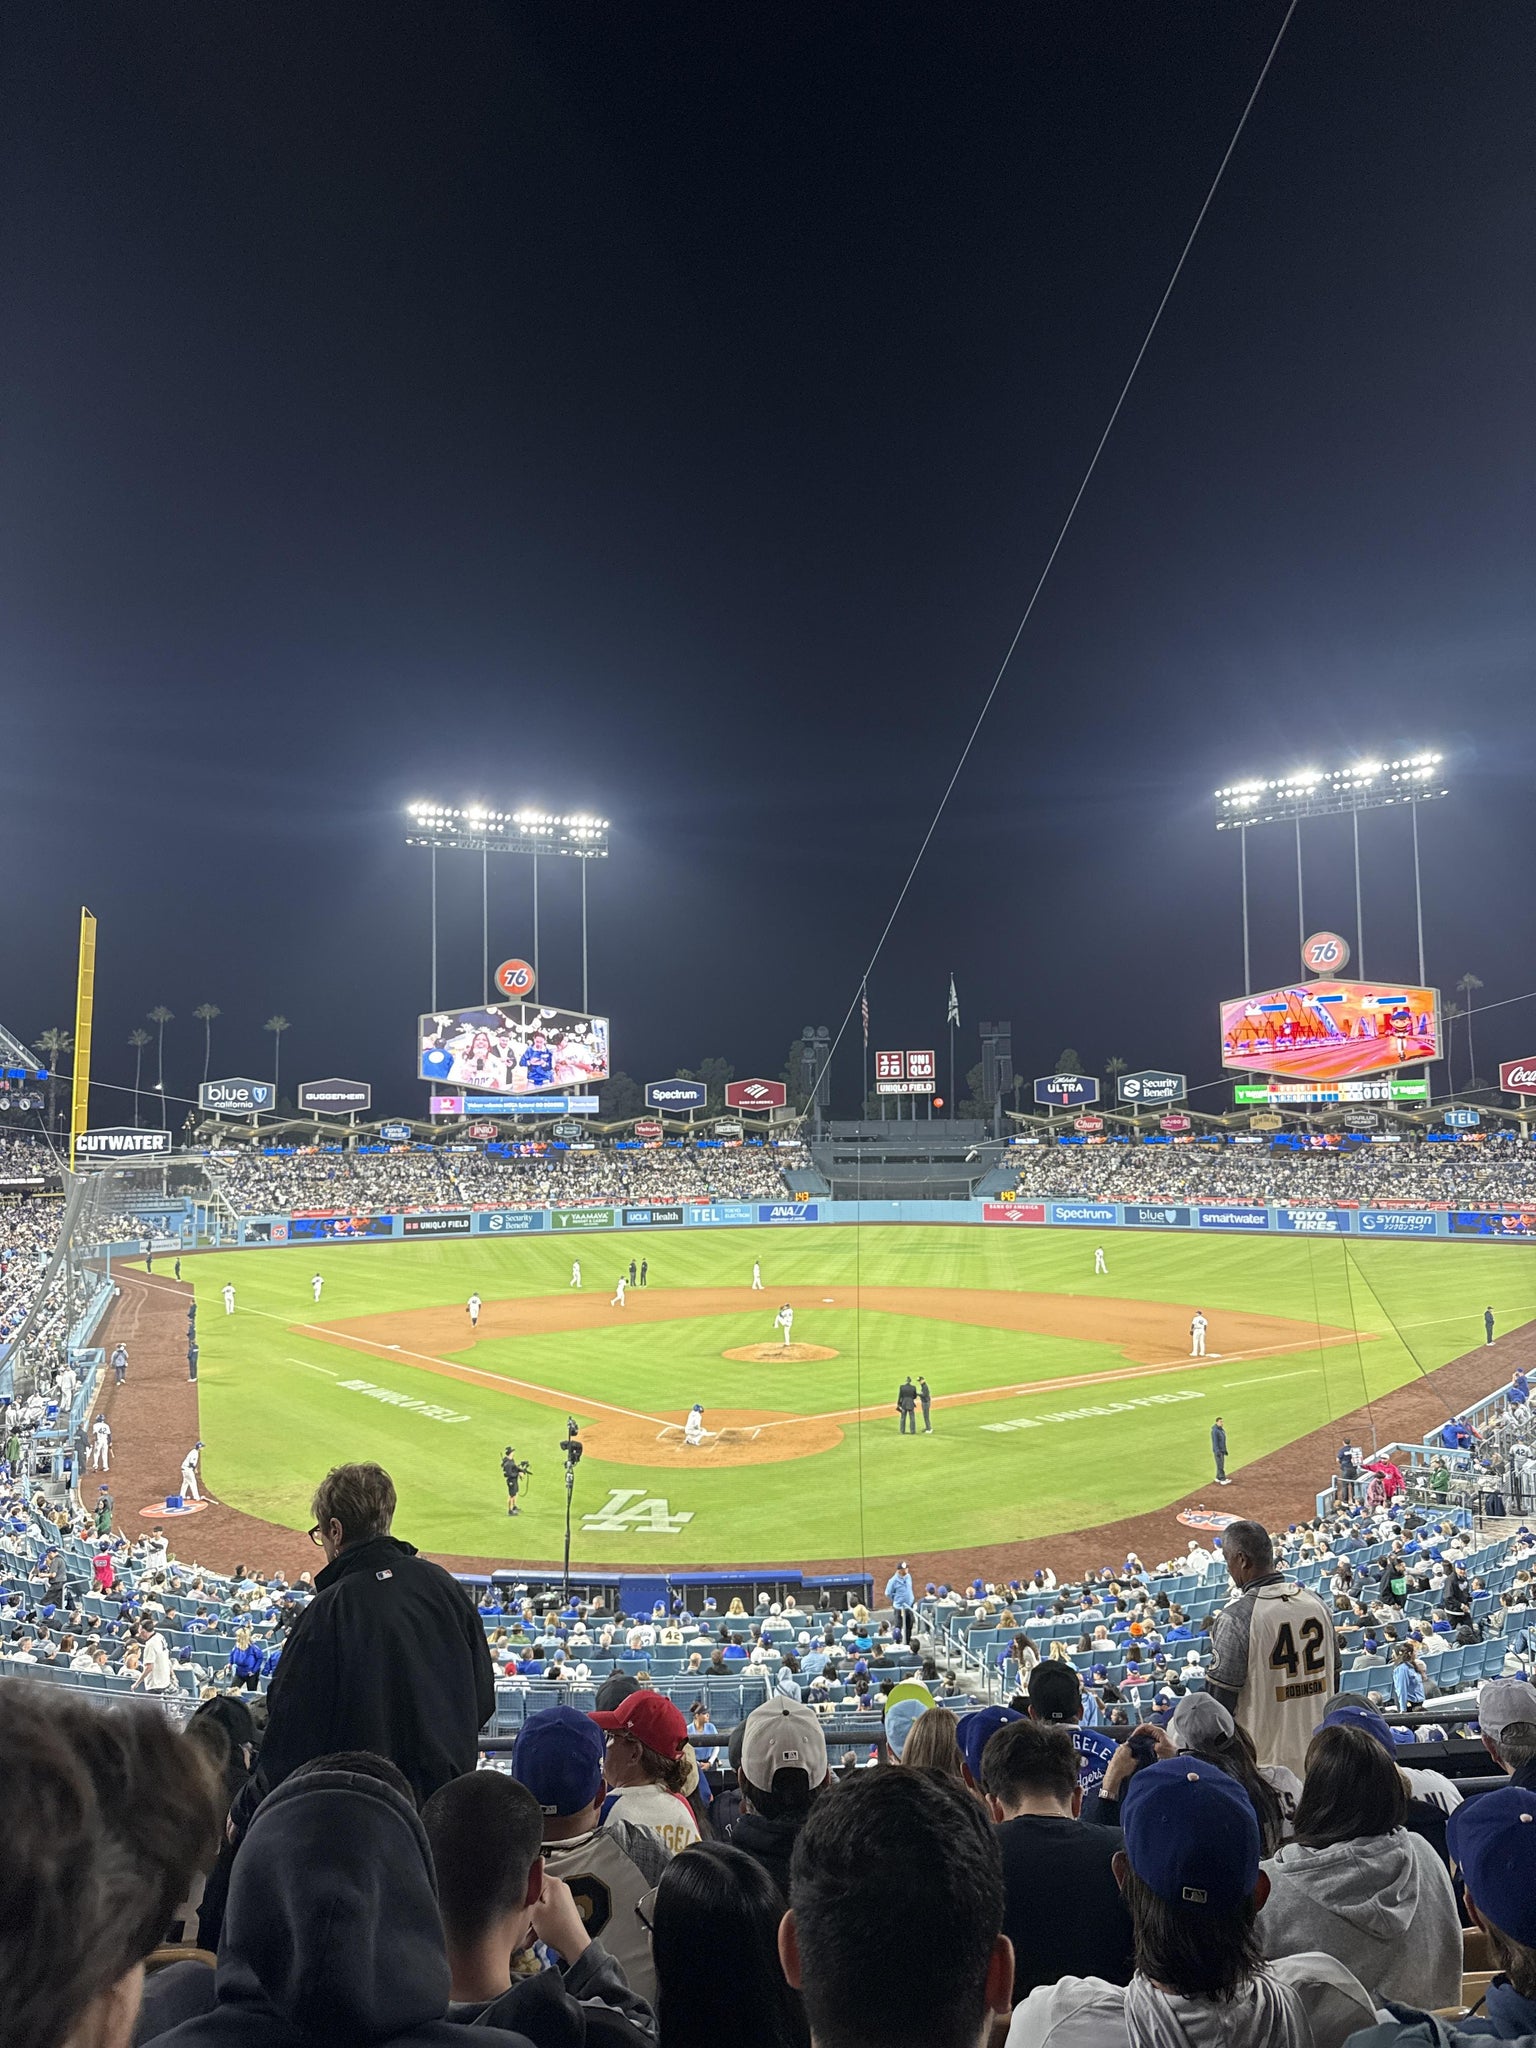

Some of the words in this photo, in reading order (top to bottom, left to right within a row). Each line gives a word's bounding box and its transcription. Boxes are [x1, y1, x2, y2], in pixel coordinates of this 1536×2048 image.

[1311, 940, 1339, 963] 76
[505, 968, 529, 988] 76
[910, 1054, 929, 1065] UNI
[910, 1065, 932, 1076] QLO
[879, 1083, 908, 1092] UNIQLO
[909, 1082, 932, 1092] FIELD
[1047, 1083, 1084, 1093] ULTRA
[1143, 1079, 1178, 1089] Security
[207, 1085, 249, 1101] blue
[305, 1092, 366, 1100] GUGGENHEIM
[652, 1089, 698, 1101] Spectrum
[1143, 1087, 1174, 1097] Benefit
[1449, 1113, 1475, 1124] TEL
[474, 1126, 494, 1135] JINRO
[76, 1135, 164, 1151] CUTWATER
[629, 1213, 649, 1221] UCLA
[652, 1211, 679, 1221] Health
[691, 1208, 720, 1222] TEL
[770, 1206, 794, 1217] ANA
[1056, 1207, 1108, 1220] Spectrum
[1139, 1209, 1164, 1220] blue
[1287, 1211, 1327, 1220] TOYO
[505, 1214, 533, 1224] Security
[1202, 1213, 1265, 1224] smartwater
[1376, 1215, 1432, 1225] SYNCRON
[420, 1221, 447, 1230] UNIQLO
[448, 1220, 469, 1229] FIELD
[505, 1221, 530, 1229] Benefit
[1294, 1220, 1338, 1231] TIRES
[273, 1227, 286, 1237] 76
[1035, 1403, 1136, 1423] UNIQLO
[1130, 1390, 1206, 1407] FIELD
[1515, 1448, 1526, 1456] 42
[580, 1488, 696, 1533] LA
[665, 1630, 681, 1640] 42
[1268, 1616, 1326, 1678] 42
[1285, 1681, 1323, 1698] ROBINSON
